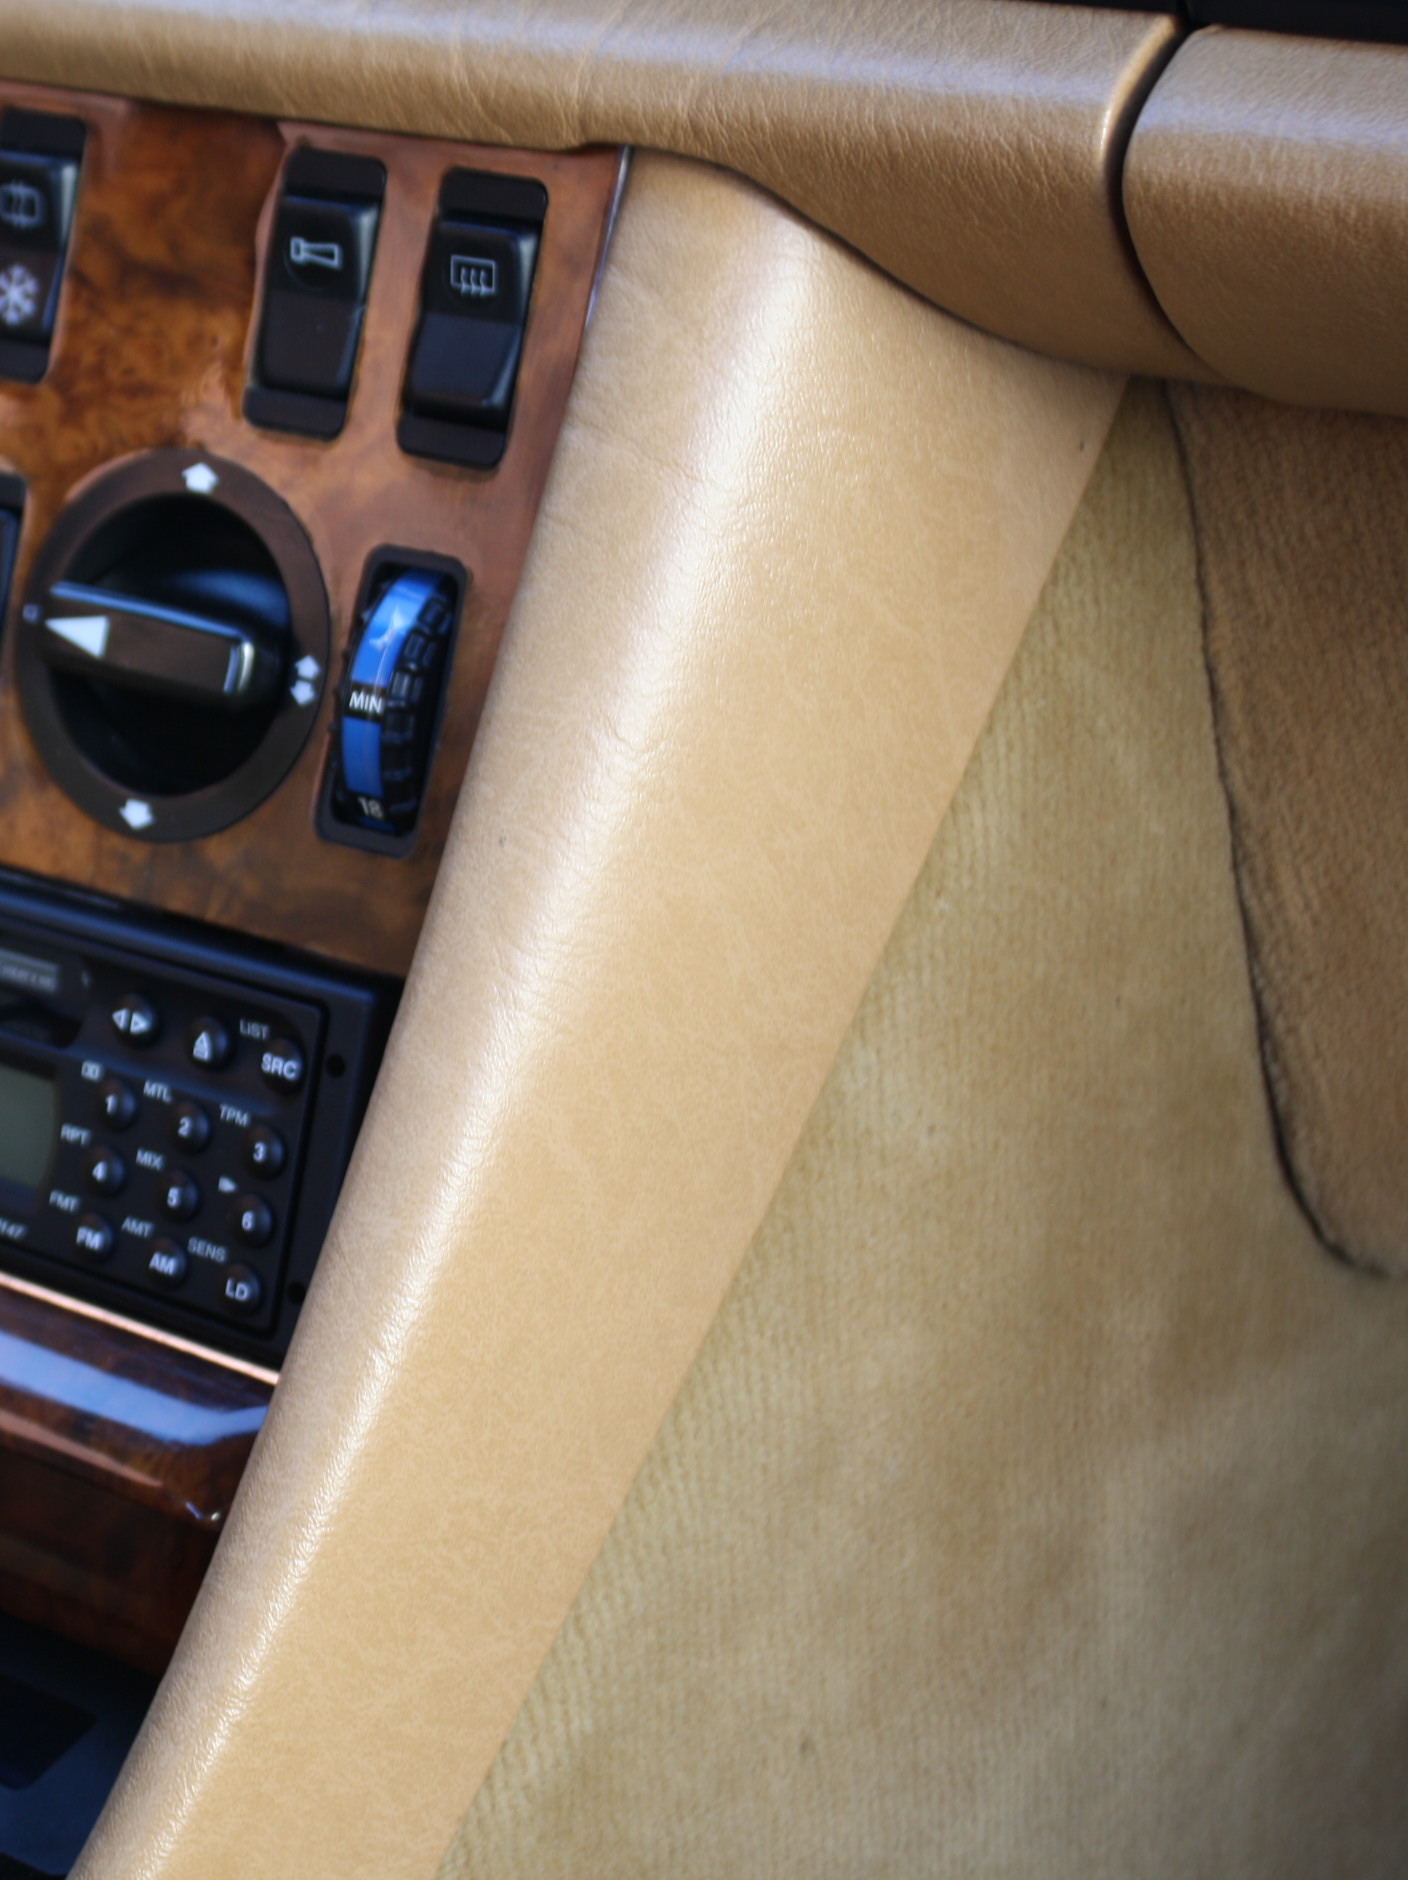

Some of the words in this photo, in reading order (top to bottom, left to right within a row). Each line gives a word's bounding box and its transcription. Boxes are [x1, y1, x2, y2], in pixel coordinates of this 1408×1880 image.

[350, 691, 384, 712] MIN
[240, 1019, 269, 1039] LIST
[262, 1052, 296, 1079] SRC
[144, 1080, 172, 1101] MTL
[106, 1095, 116, 1113] 1
[220, 1104, 249, 1126] TPM
[61, 1125, 90, 1145] RPT
[178, 1117, 191, 1136] 2
[136, 1149, 165, 1169] MIX
[253, 1142, 265, 1161] 3
[92, 1162, 106, 1180] 4
[167, 1188, 179, 1206] 5
[123, 1217, 153, 1237] AMT
[242, 1212, 253, 1230] 6
[77, 1227, 103, 1249] FM
[188, 1238, 228, 1261] SENS
[149, 1253, 177, 1274] AM
[225, 1278, 248, 1299] LD
